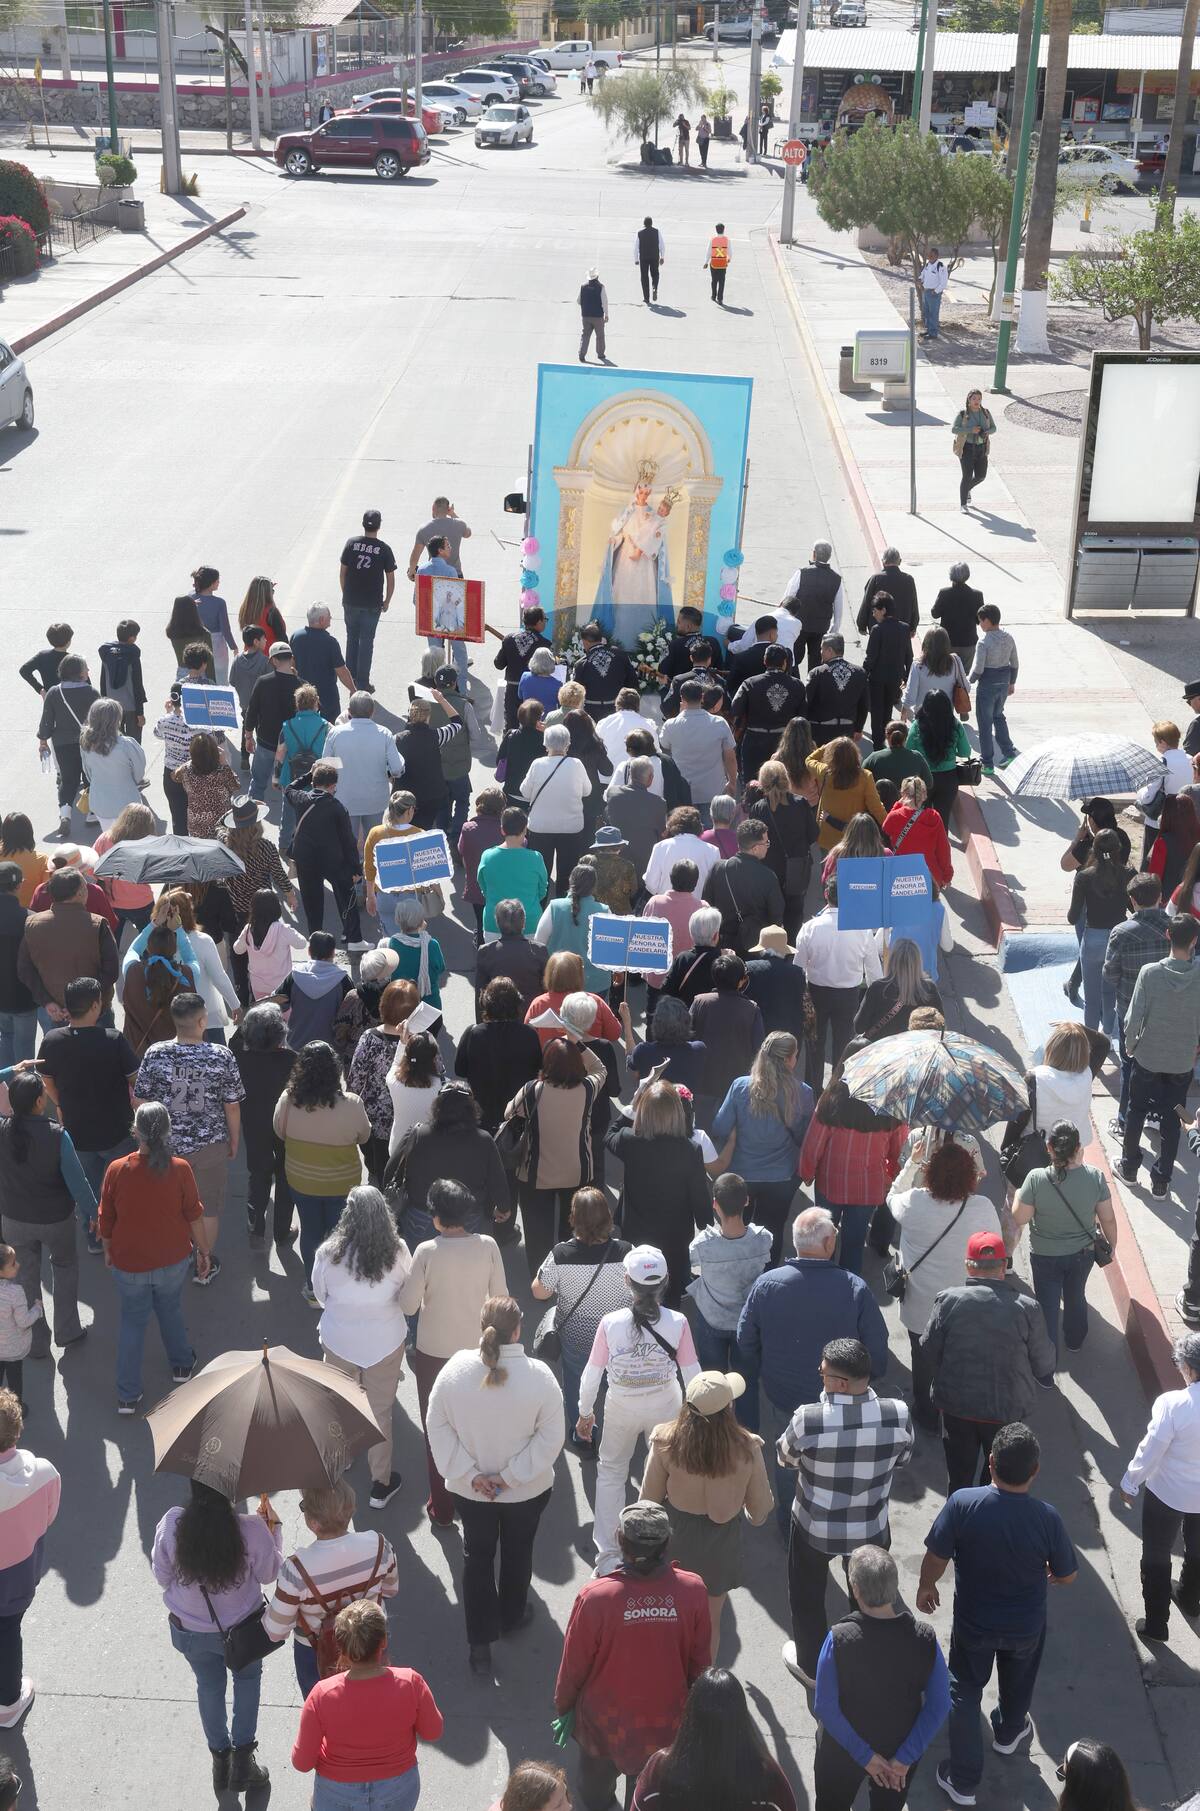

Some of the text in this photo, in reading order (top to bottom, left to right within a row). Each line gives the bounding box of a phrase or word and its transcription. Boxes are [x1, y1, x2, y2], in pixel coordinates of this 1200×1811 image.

[783, 147, 805, 159] ALTO
[869, 357, 888, 366] 8319
[356, 554, 372, 569] 72
[414, 847, 442, 858] NUESTRA
[412, 859, 448, 870] CANDELARIA
[891, 888, 928, 896] CANDELARIA
[634, 933, 664, 941] NUESTRA
[628, 946, 668, 954] CANDELARIA
[171, 1066, 208, 1080] LOPEZ
[170, 1081, 206, 1113] 23
[631, 1342, 659, 1359] XV
[623, 1607, 678, 1621] SONORA
